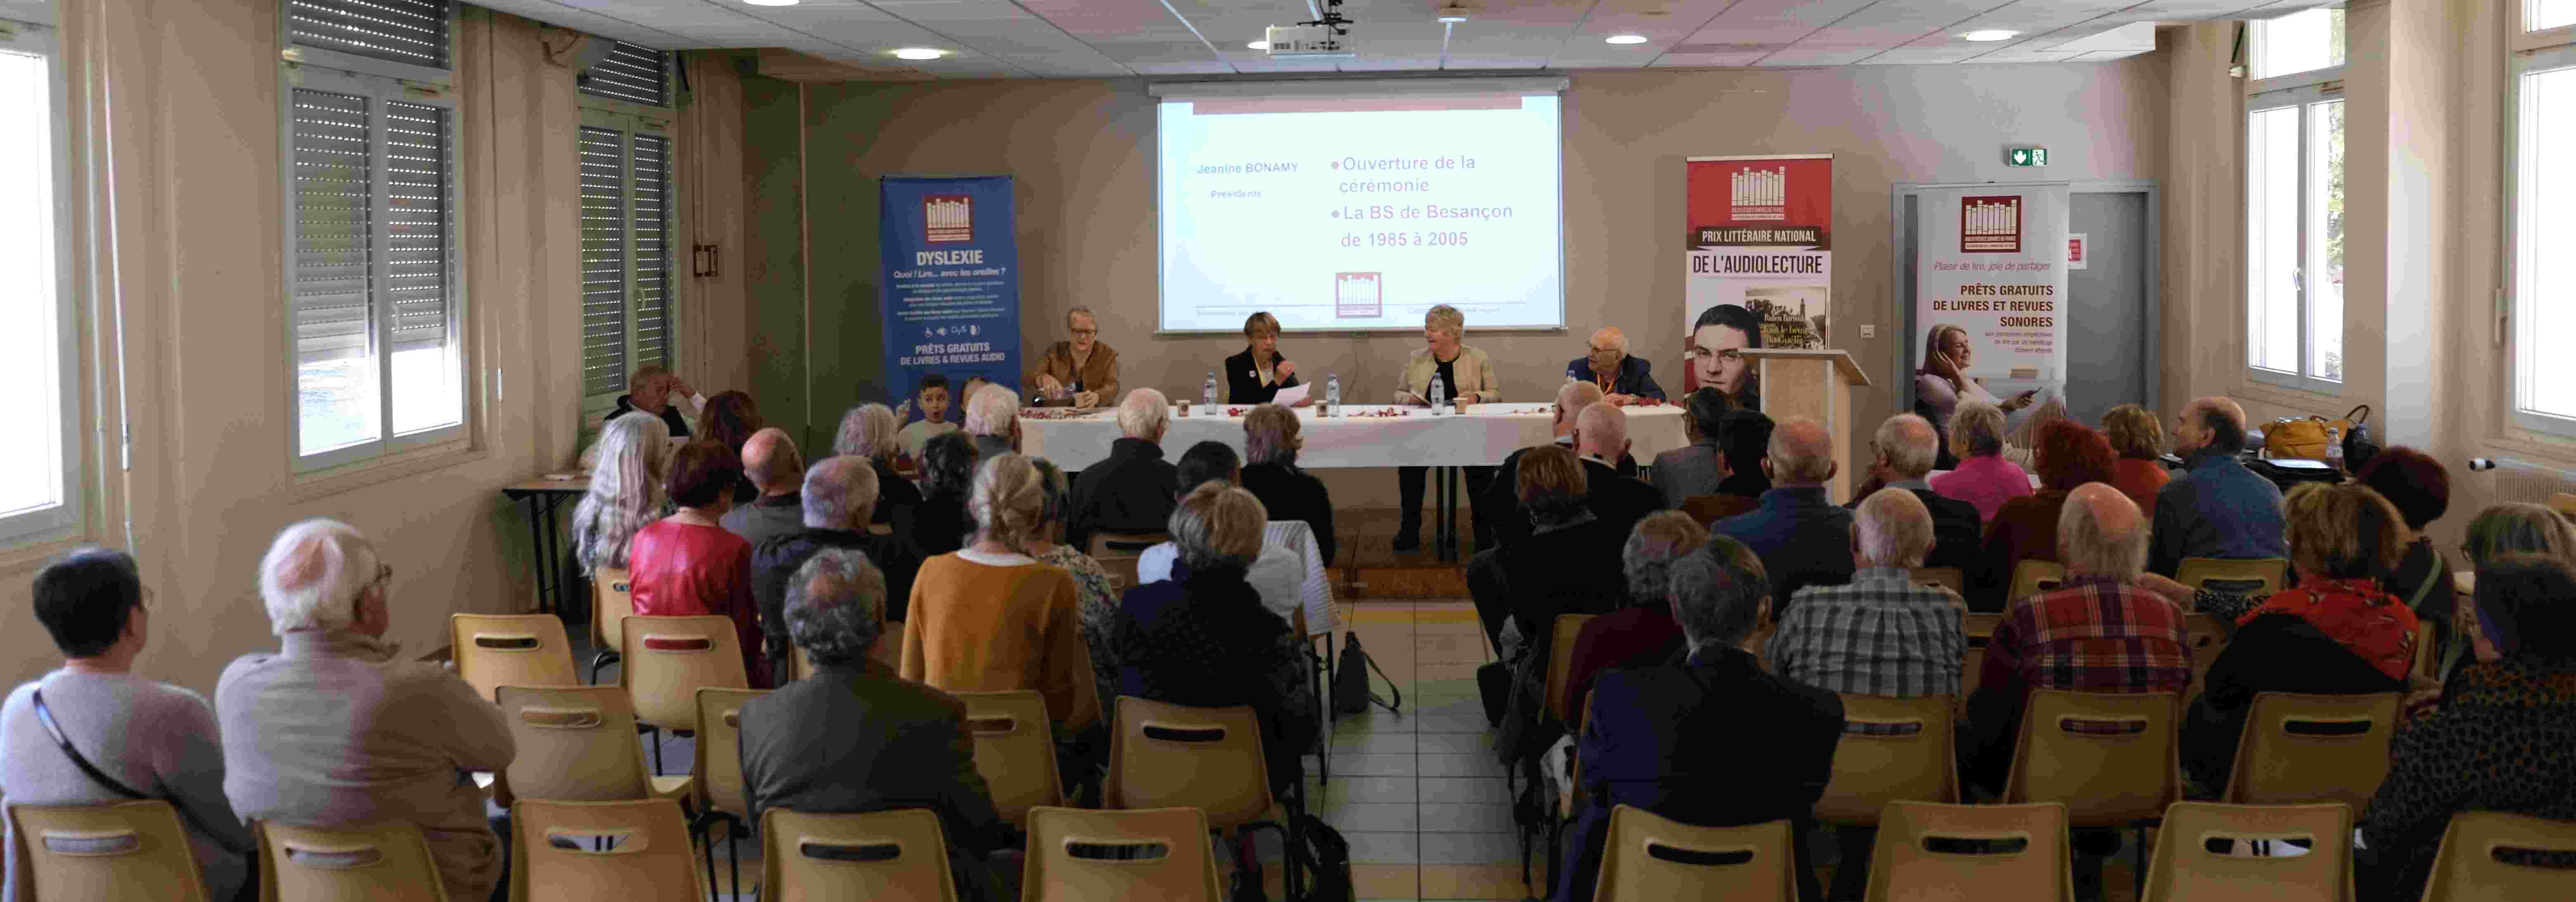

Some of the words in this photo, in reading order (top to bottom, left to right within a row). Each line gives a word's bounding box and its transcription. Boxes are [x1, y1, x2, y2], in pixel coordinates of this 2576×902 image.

[1197, 164, 1242, 175] Jeanine
[1246, 163, 1298, 173] BONAMY
[1343, 156, 1428, 171] Ouverture
[1435, 156, 1454, 170] de
[1461, 156, 1475, 169] la
[1339, 179, 1429, 193] cérémonie
[1344, 205, 1364, 220] La
[1370, 205, 1394, 219] BS
[1400, 205, 1420, 219] de
[1427, 205, 1513, 222] Besançon
[1341, 233, 1361, 247] de
[1368, 233, 1407, 246] 1985
[1413, 231, 1421, 246] à
[1428, 231, 1468, 246] 2005
[1702, 231, 1722, 242] PRIX
[1724, 229, 1772, 241] LITTÉRAIRE
[1775, 229, 1816, 241] NATIONAL
[917, 250, 983, 265] DYSLEXIE
[1694, 255, 1709, 273] DE
[1714, 256, 1822, 273] L'AUDIOLECTURE
[1934, 262, 1958, 271] Plaisir
[1960, 262, 1970, 271] de
[1988, 262, 2003, 272] joie
[2005, 262, 2015, 271] de
[2017, 262, 2050, 273] partager
[1961, 283, 1996, 295] PRÊTS
[2000, 285, 2053, 295] GRATUITS
[1934, 301, 1947, 310] DE
[1951, 301, 1989, 311] LIVRES
[1993, 301, 2006, 310] ET
[2010, 301, 2053, 311] REVUES
[2000, 316, 2053, 327] SONORES
[916, 343, 945, 354] PRÊTS
[947, 342, 990, 353] GRATUITS
[900, 357, 912, 365] DE
[914, 356, 940, 365] LIVRES
[951, 354, 980, 364] REVUES
[982, 353, 1005, 362] AUDIO
